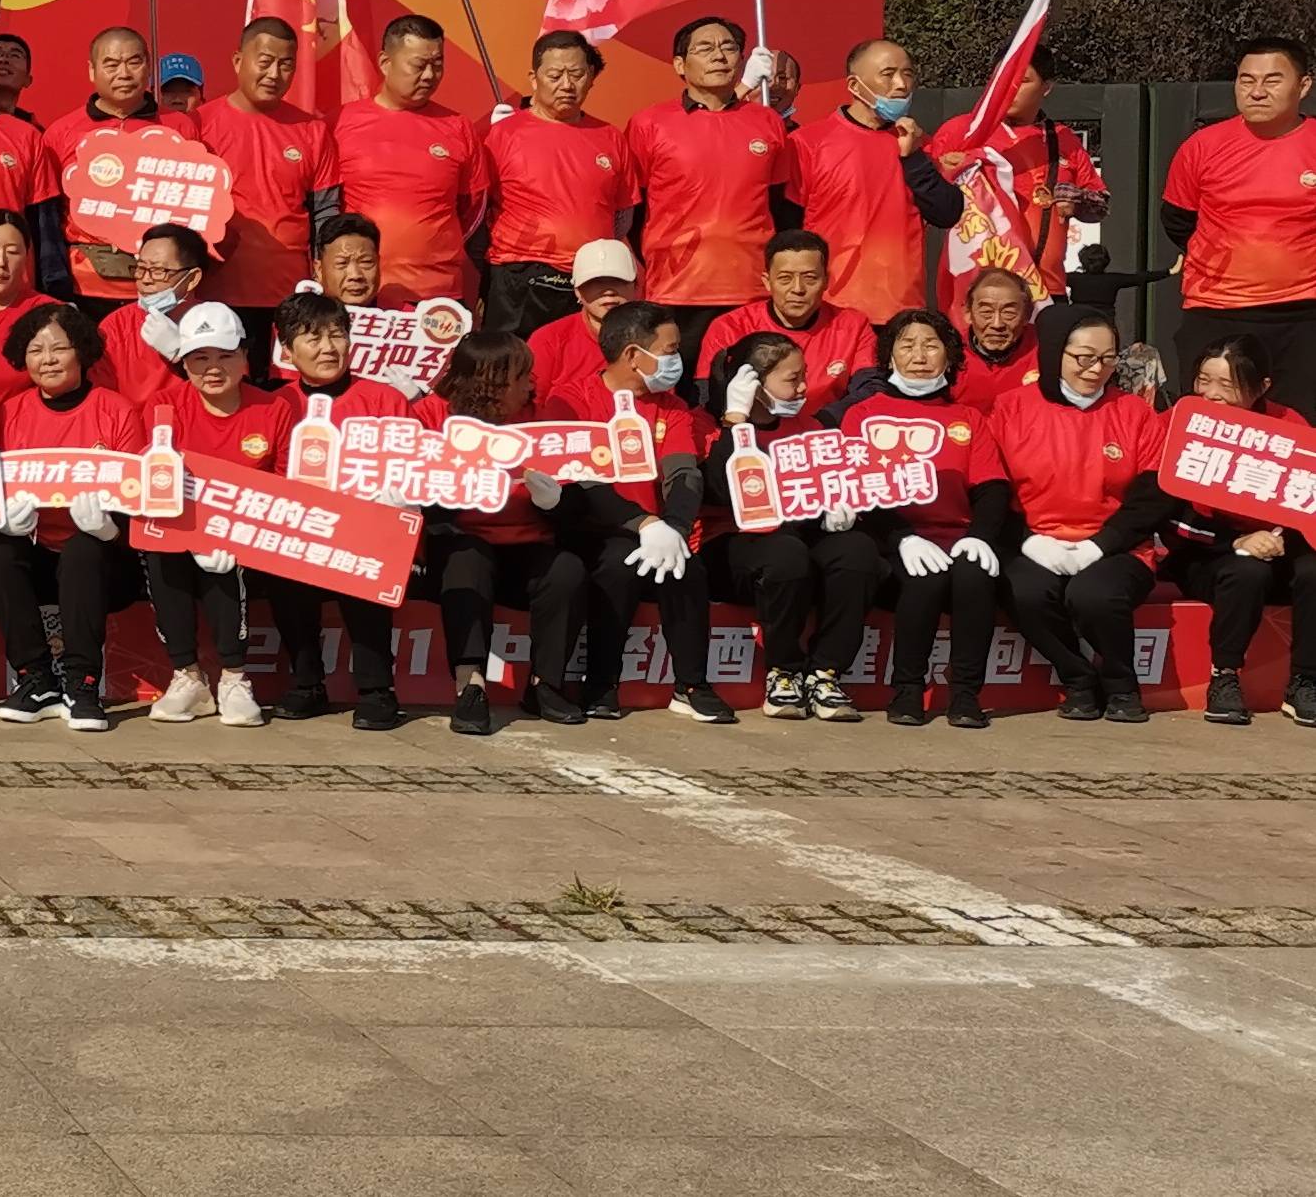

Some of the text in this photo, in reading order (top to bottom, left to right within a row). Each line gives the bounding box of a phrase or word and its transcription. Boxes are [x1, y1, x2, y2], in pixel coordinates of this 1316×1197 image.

[126, 178, 215, 211] 卡路里
[349, 312, 418, 341] 生活
[345, 421, 447, 463] 跑起来
[775, 433, 869, 474] 跑起来
[339, 458, 504, 505] 无所畏惧
[781, 462, 933, 514] 无所畏惧
[203, 514, 385, 581] 含着泪也要跑完
